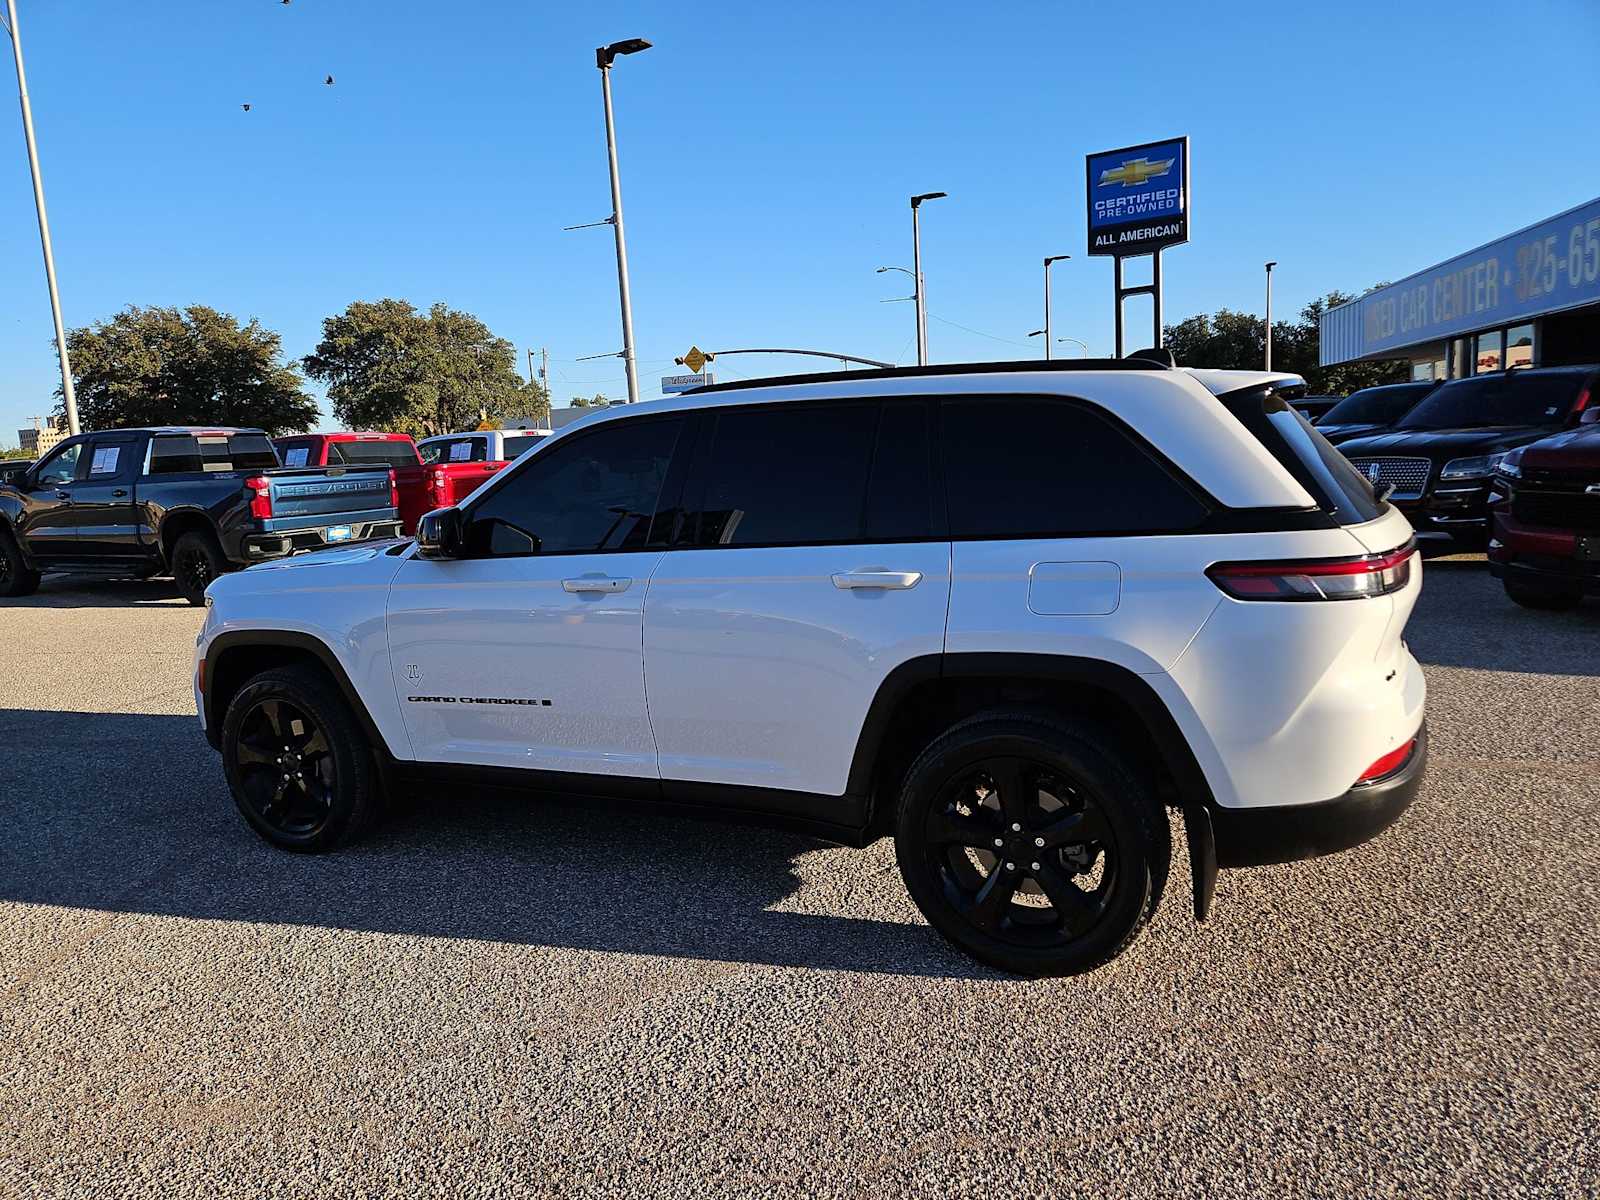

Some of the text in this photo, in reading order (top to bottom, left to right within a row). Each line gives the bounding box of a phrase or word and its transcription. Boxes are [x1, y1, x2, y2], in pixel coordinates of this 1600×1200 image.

[1095, 189, 1178, 209] CERTIFIED
[1098, 199, 1174, 219] PRE-OWNED
[1096, 224, 1179, 246] ALL AMERICAN
[1400, 286, 1428, 333] CAR
[1432, 258, 1498, 323] CENTER
[459, 697, 539, 706] CHEROKEE
